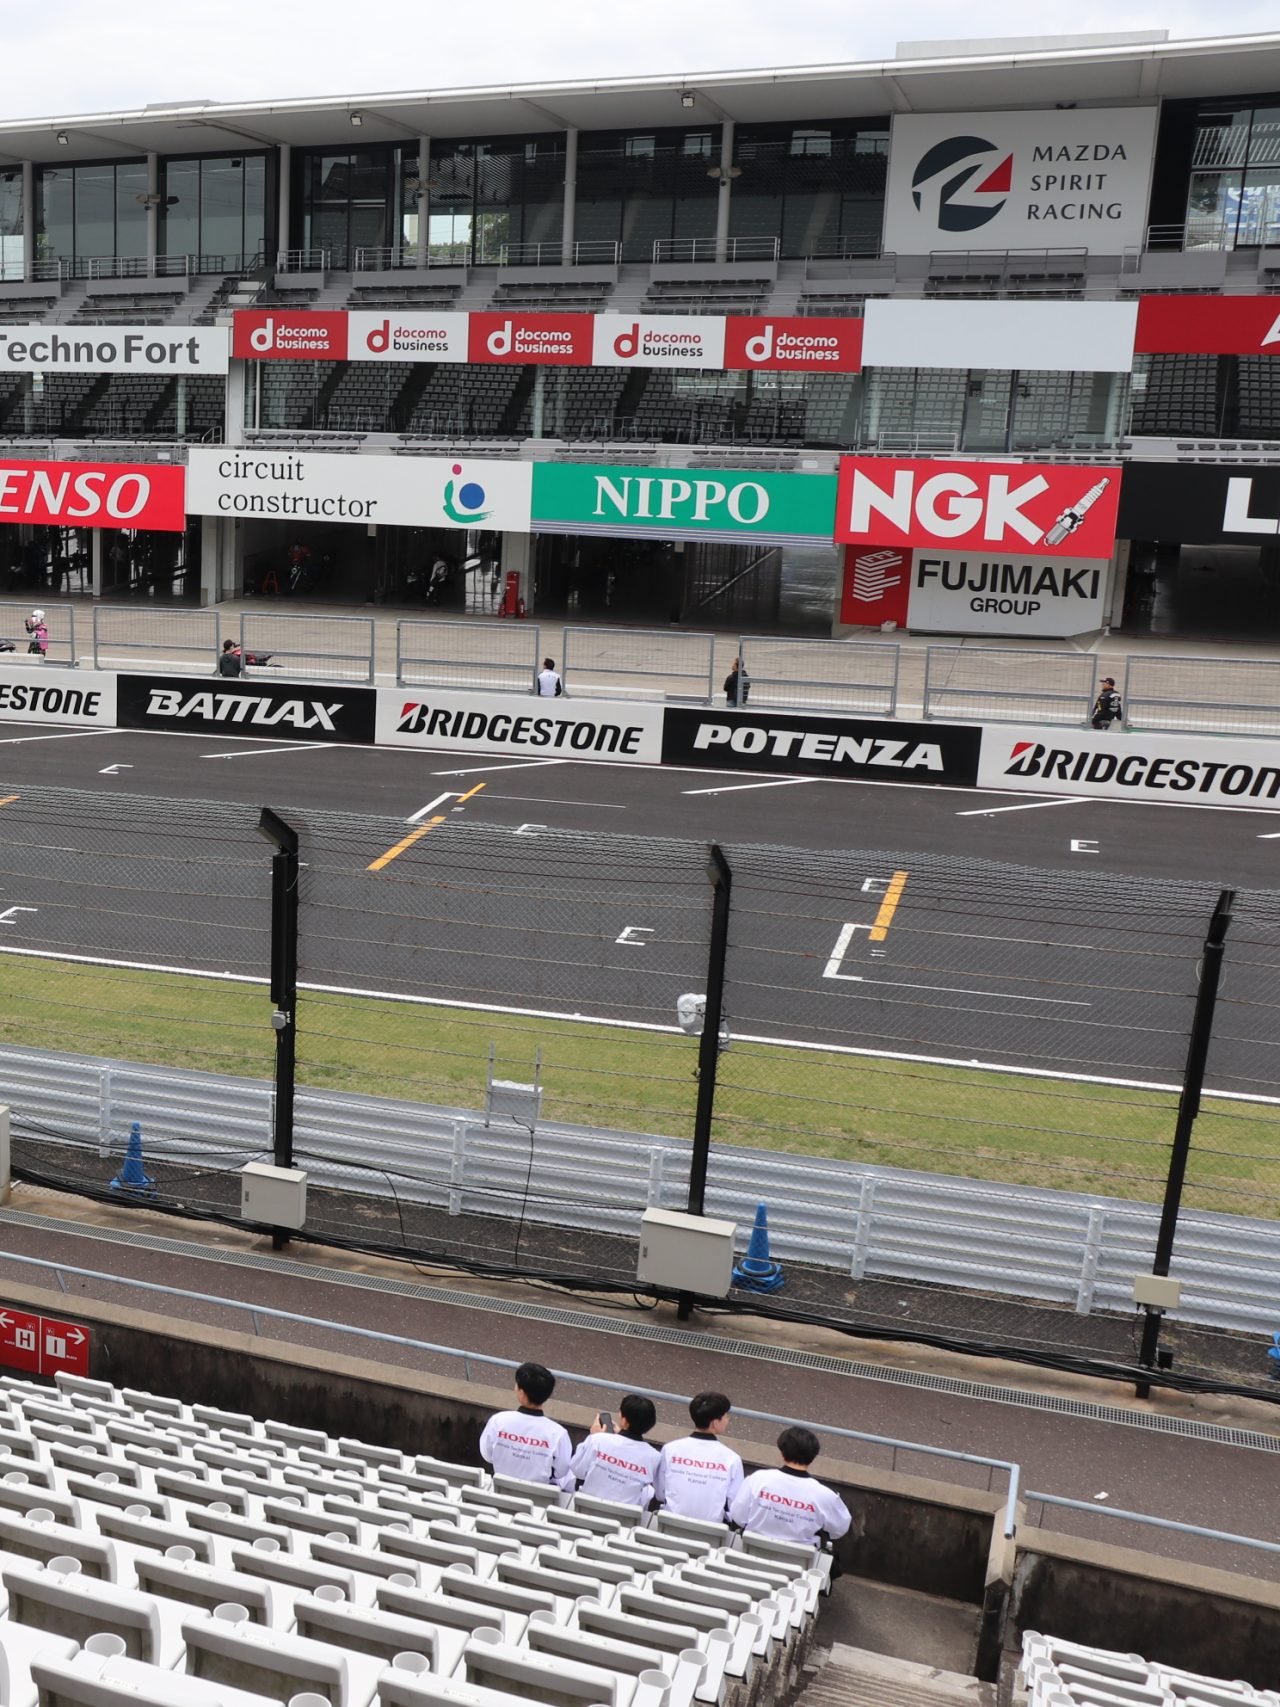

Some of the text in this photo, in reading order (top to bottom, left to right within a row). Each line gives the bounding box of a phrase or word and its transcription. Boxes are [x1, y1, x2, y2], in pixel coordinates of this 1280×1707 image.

[1033, 145, 1126, 161] MAZDA
[1031, 174, 1107, 191] SPIRIT
[1028, 203, 1121, 219] RACING
[277, 325, 327, 337] docomo
[394, 327, 446, 338] docomo
[516, 328, 571, 341] docomo
[644, 331, 701, 343] docomo
[777, 333, 837, 346] docomo
[125, 335, 199, 364] Fort
[276, 337, 330, 350] business
[394, 339, 448, 351] business
[515, 341, 573, 353] business
[643, 344, 703, 356] business
[776, 345, 840, 361] business
[218, 454, 305, 481] circuit
[218, 490, 378, 519] constructor
[592, 475, 770, 525] NIPPO
[849, 468, 1050, 545] NGK
[1222, 477, 1280, 535] L
[917, 559, 1101, 600] FUJIMAKI
[969, 596, 1041, 616] GROUP
[396, 702, 644, 755] BRIDGESTONE
[693, 723, 945, 772] POTENZA
[20, 1331, 30, 1348] H
[497, 1431, 550, 1448] HONDA
[596, 1451, 647, 1475] HONDA
[671, 1456, 728, 1472] HONDA
[759, 1490, 815, 1512] HONDA
